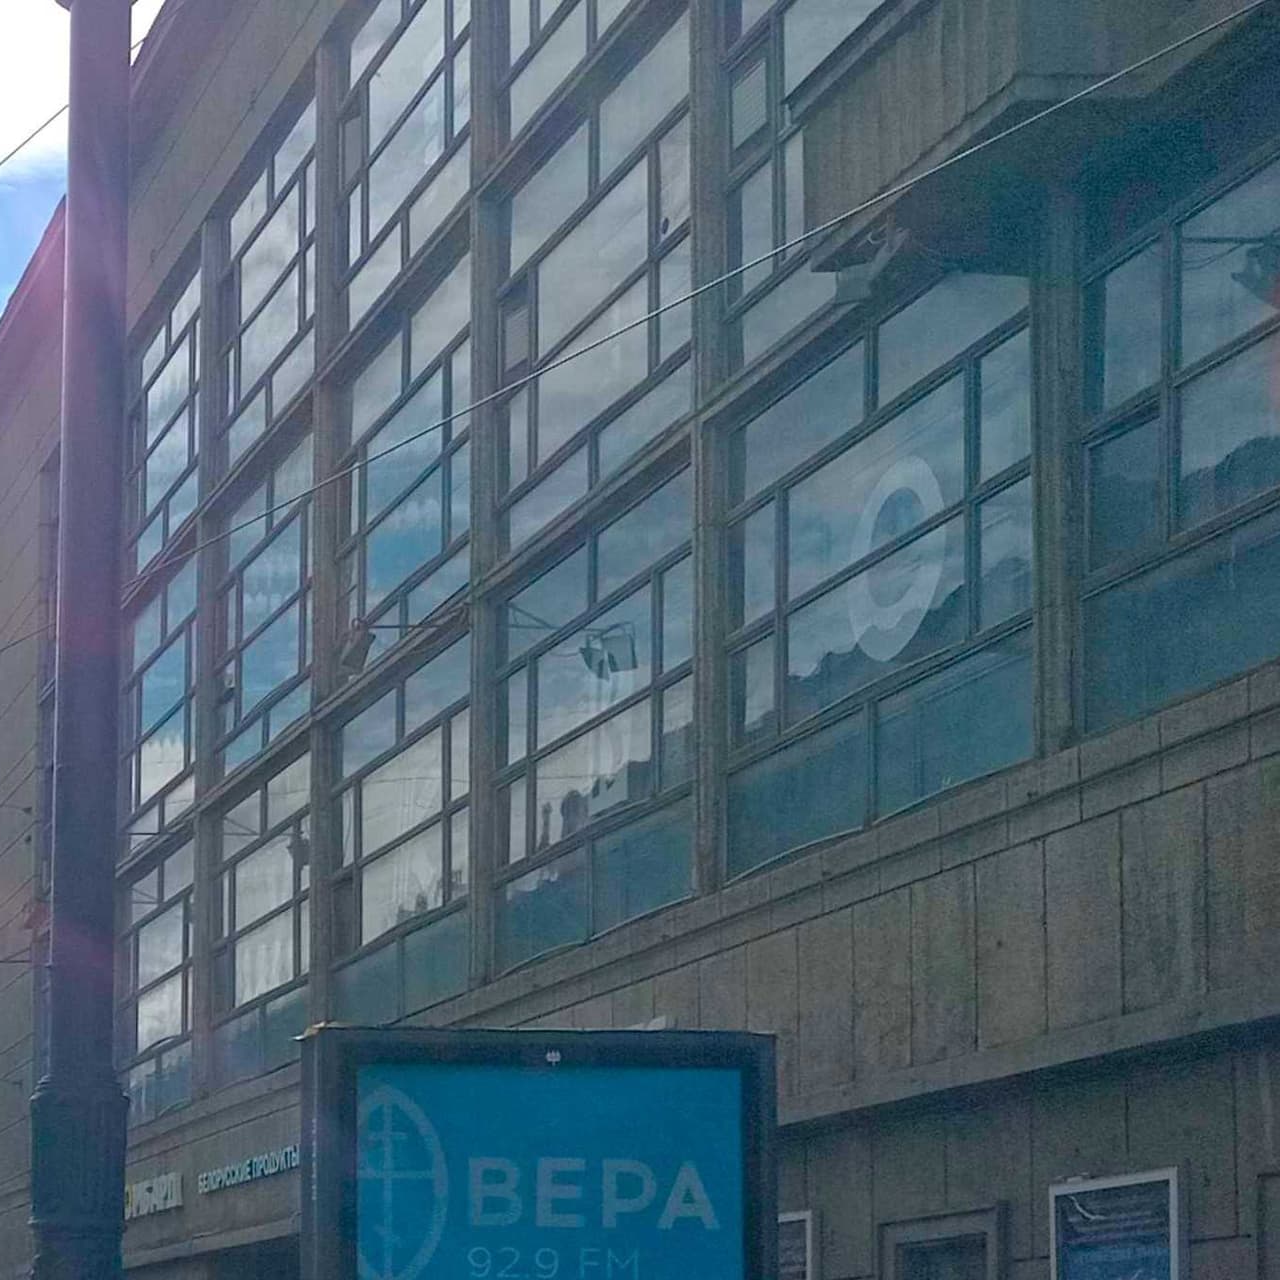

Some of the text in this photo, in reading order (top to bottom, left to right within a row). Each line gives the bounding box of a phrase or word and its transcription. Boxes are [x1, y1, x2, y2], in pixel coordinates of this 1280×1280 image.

[198, 1160, 251, 1195] БЕЛОРУССКИЕ
[252, 1143, 300, 1178] ПРОДУКТЫ
[469, 1156, 721, 1231] ВЕРА
[467, 1246, 640, 1280] 92.9 FM
